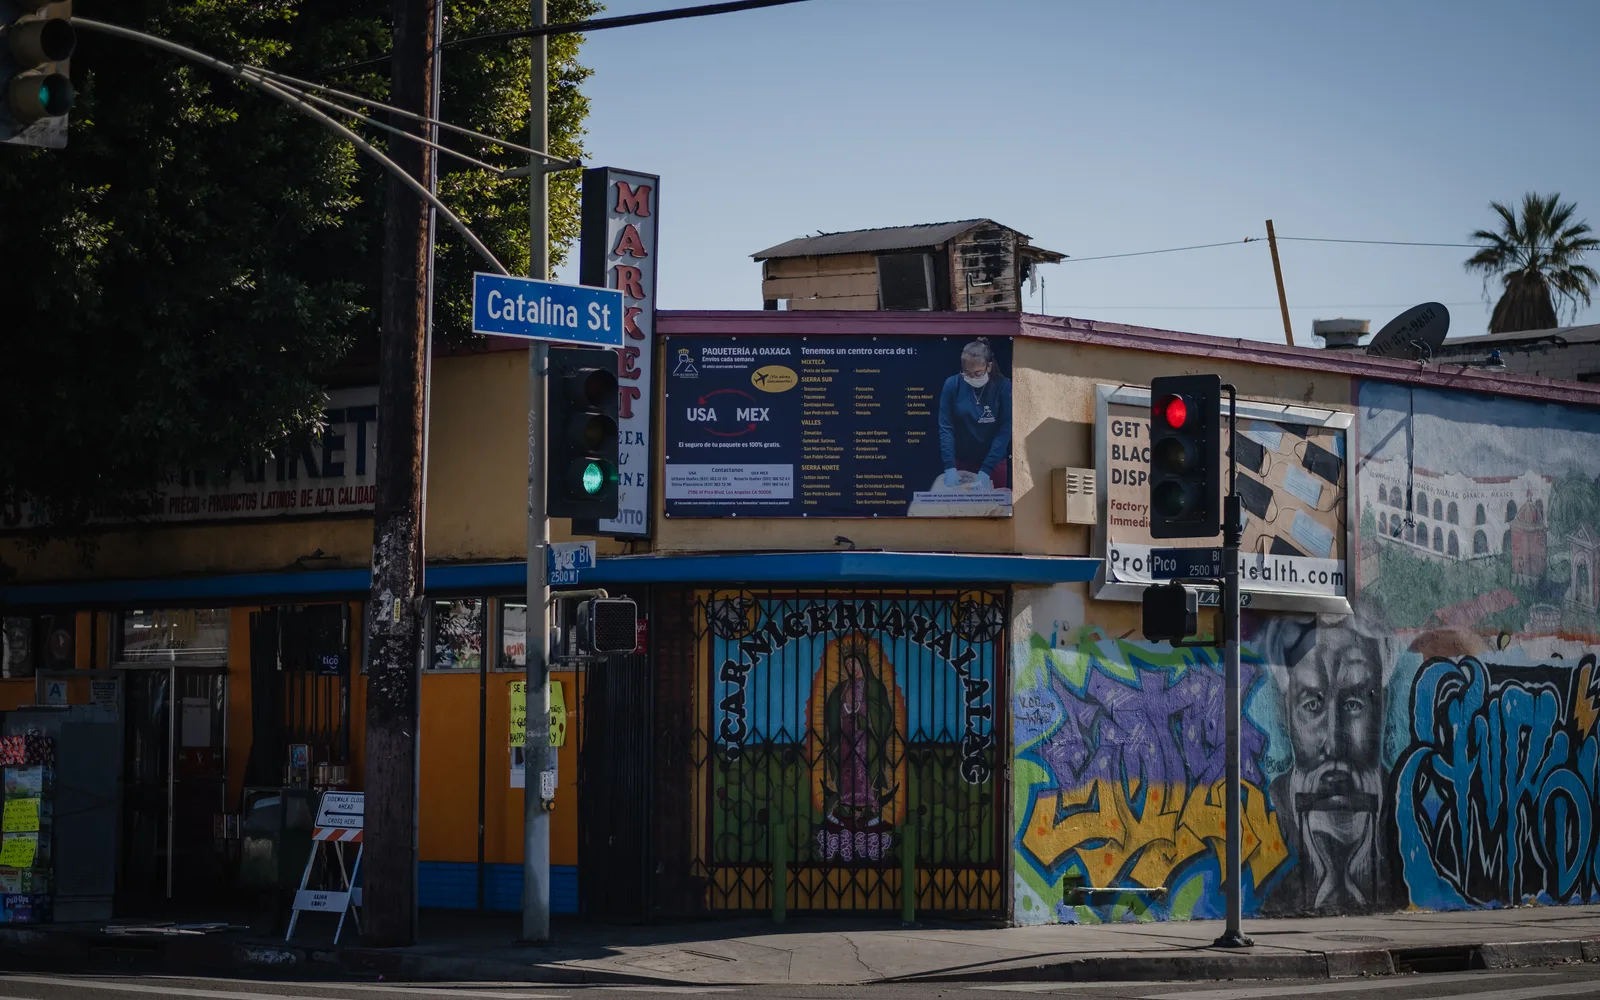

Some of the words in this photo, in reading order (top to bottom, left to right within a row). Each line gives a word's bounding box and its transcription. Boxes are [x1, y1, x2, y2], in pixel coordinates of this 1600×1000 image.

[615, 181, 652, 419] MARKET
[487, 289, 578, 328] Catalina
[587, 301, 612, 332] St
[702, 346, 750, 356] PAQUETERÍA
[752, 346, 757, 356] A
[759, 346, 791, 356] OAXACA
[686, 408, 717, 422] USA
[736, 408, 770, 422] MEX
[1112, 420, 1140, 438] GET
[1112, 444, 1150, 463] BLAC
[1112, 468, 1150, 486] DISP
[169, 496, 200, 514] PRECIO
[208, 492, 257, 512] PRODUCTOS
[261, 490, 296, 510] LATINOS
[300, 489, 312, 507] DE
[315, 486, 334, 506] ALTA
[338, 485, 376, 505] CALIDAD
[1111, 499, 1148, 515] Factory
[610, 508, 643, 525] OTTO
[1110, 515, 1150, 528] Immedi
[551, 570, 568, 582] 2500
[569, 570, 575, 581] W
[1189, 565, 1210, 576] 2500
[1213, 565, 1219, 575] W
[167, 640, 186, 649] 2596
[49, 683, 61, 697] A
